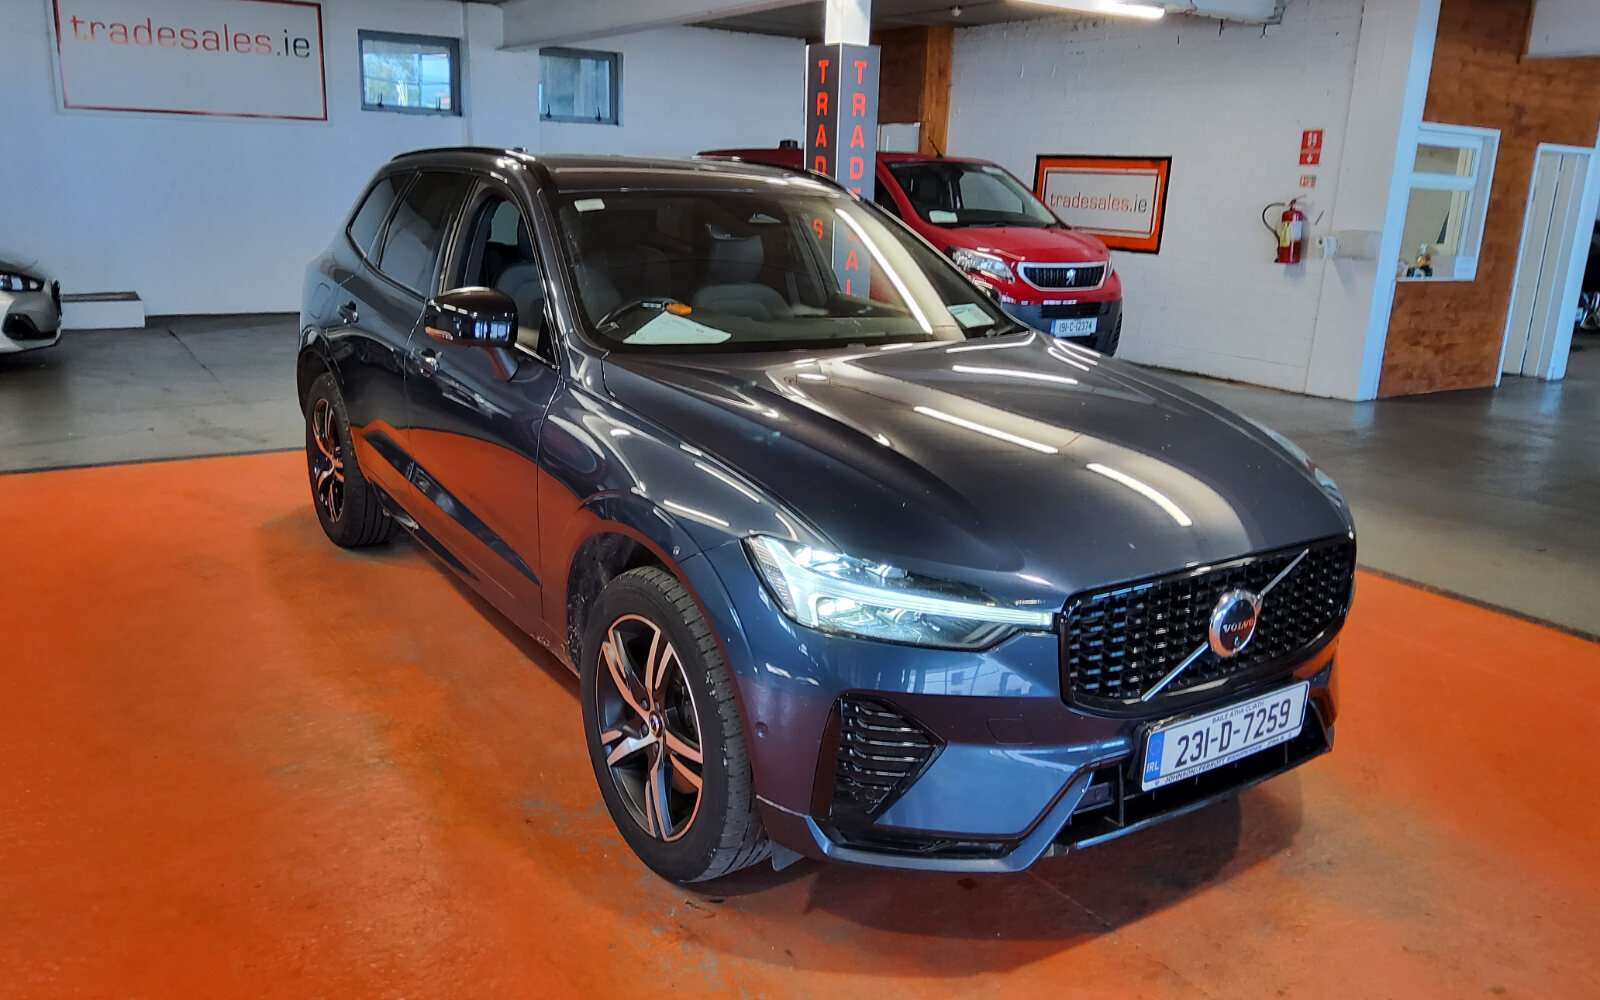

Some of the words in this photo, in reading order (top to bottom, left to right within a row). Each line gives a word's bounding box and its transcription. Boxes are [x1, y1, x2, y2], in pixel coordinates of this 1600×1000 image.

[69, 15, 311, 60] tradesales.ie
[849, 60, 867, 195] TRAD
[1049, 191, 1148, 213] tradesales.ie
[1222, 619, 1254, 634] VOLVO
[1174, 698, 1292, 769] 231-D-7259
[1146, 761, 1160, 774] IRL
